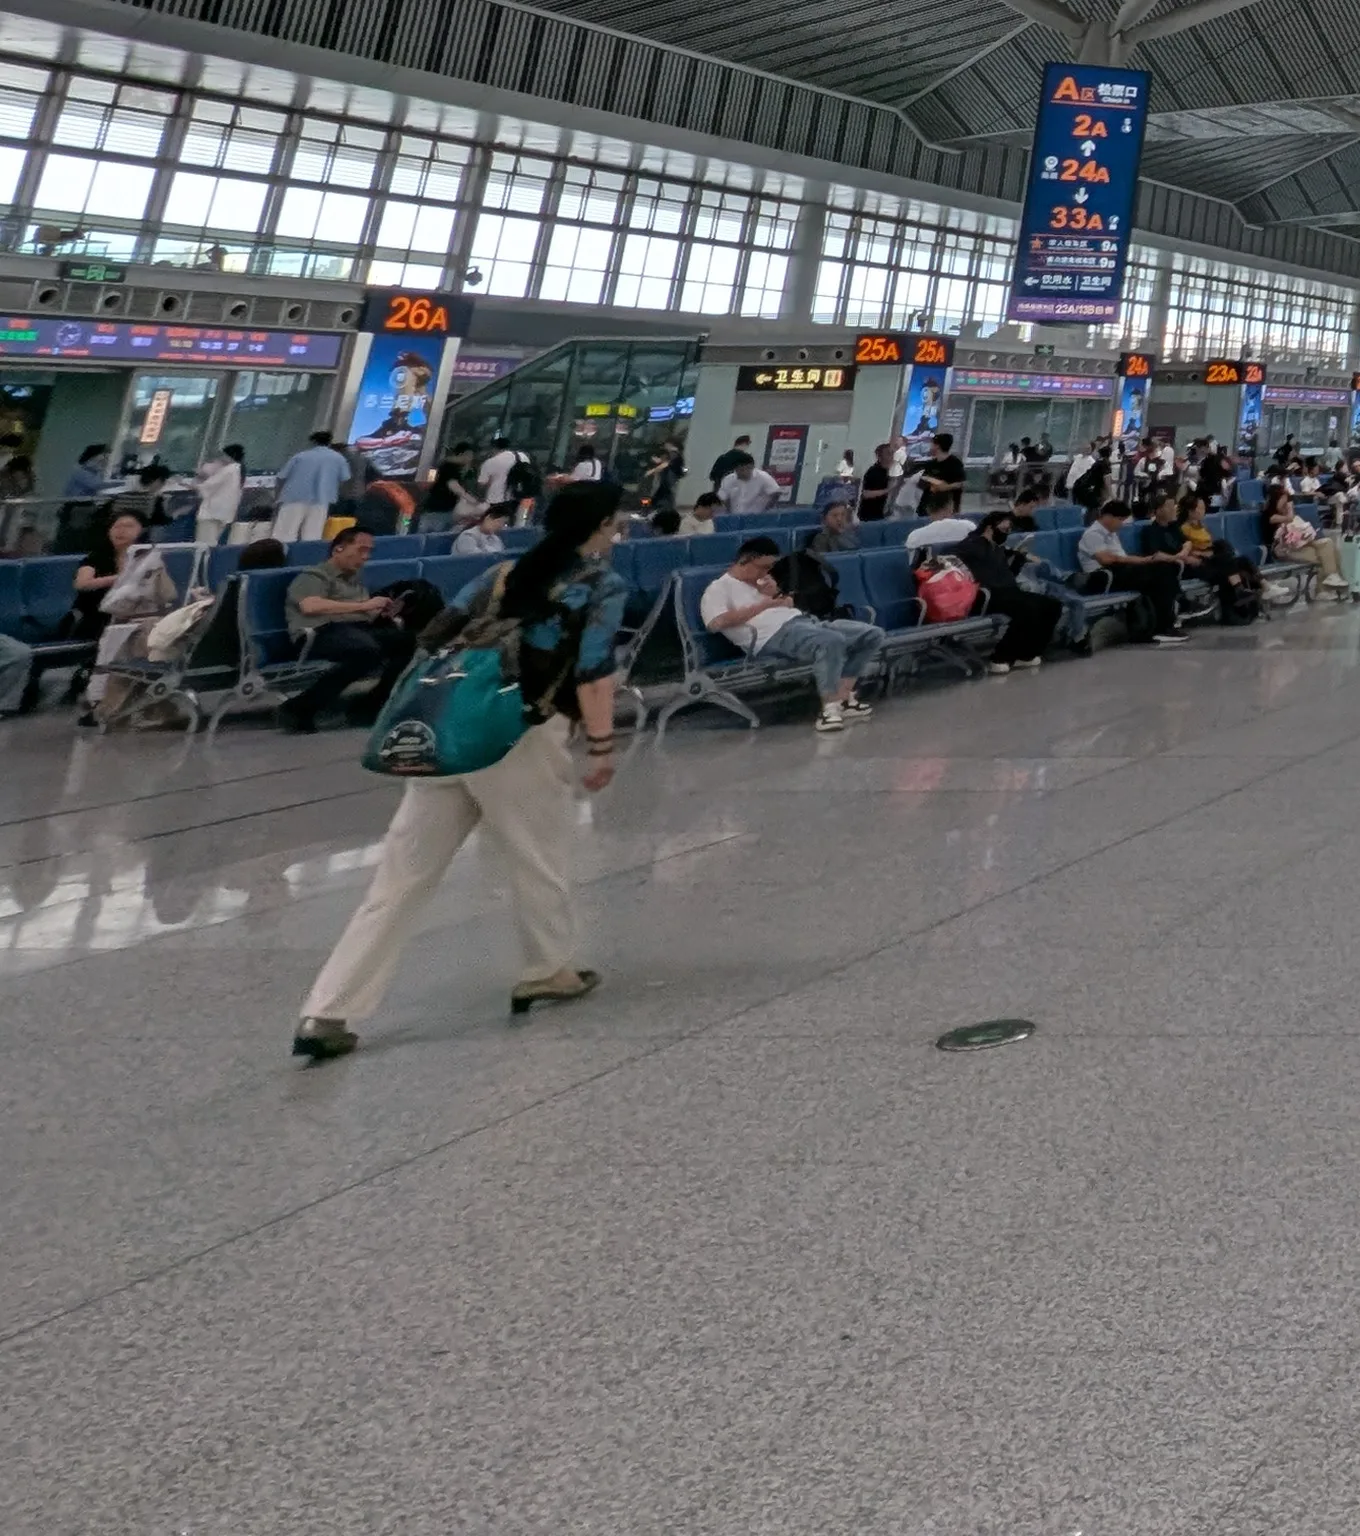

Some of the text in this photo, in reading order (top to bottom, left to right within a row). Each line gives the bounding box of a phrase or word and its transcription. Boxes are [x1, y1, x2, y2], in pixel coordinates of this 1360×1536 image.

[1072, 114, 1108, 138] 2A
[1061, 159, 1110, 183] 24A
[1050, 206, 1103, 230] 33A
[1101, 240, 1118, 252] 9A
[384, 297, 448, 332] 26A
[856, 338, 899, 361] 25A
[915, 340, 945, 363] 25A
[774, 369, 821, 383] 卫生间
[1206, 365, 1238, 382] 23A
